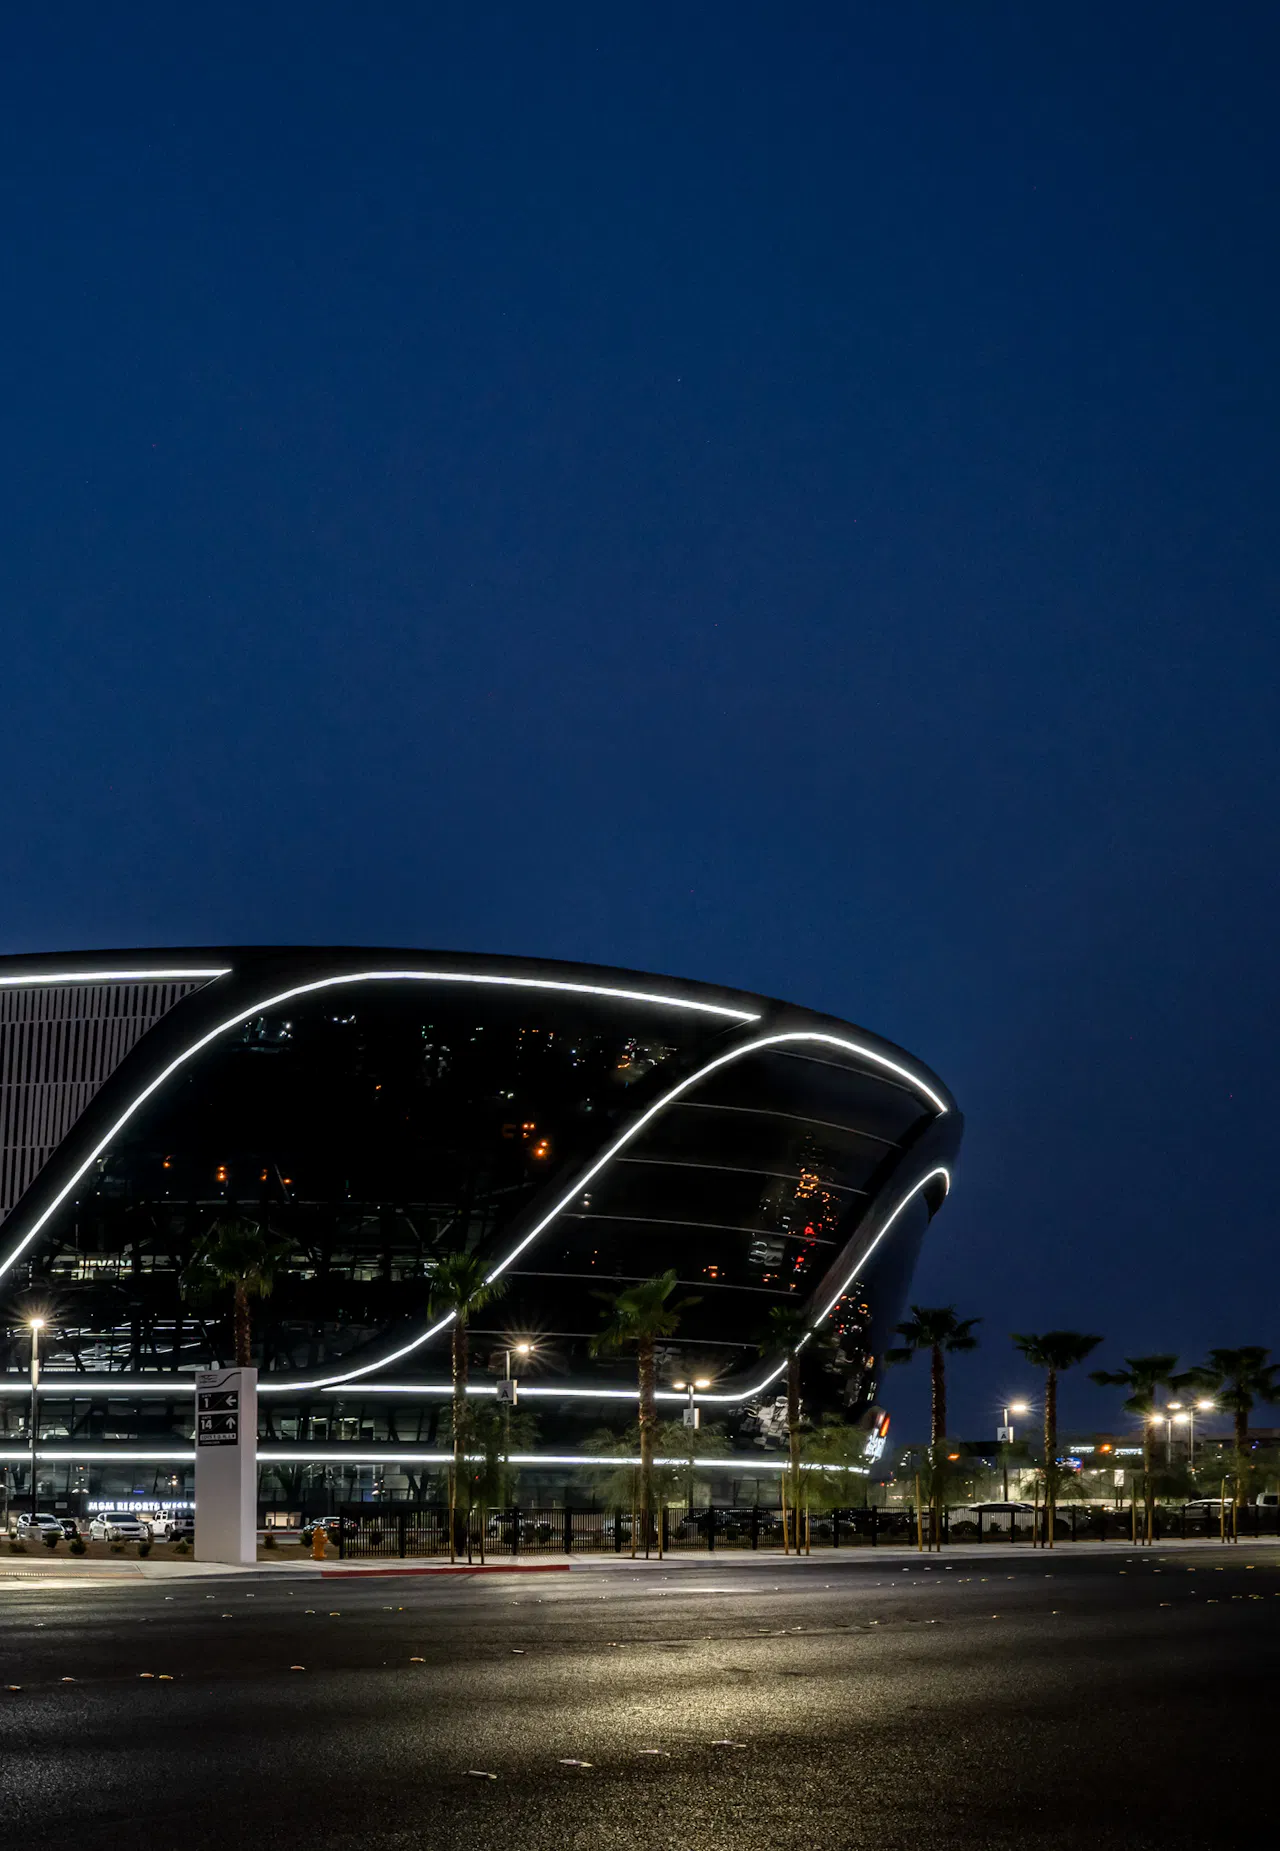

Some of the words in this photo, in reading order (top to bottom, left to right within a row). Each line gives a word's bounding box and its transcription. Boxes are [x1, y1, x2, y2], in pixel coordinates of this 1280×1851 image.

[501, 1390, 509, 1398] A
[204, 1398, 209, 1409] 1
[200, 1420, 212, 1430] 14
[87, 1501, 115, 1511] MGM
[116, 1501, 160, 1511] RESORTS
